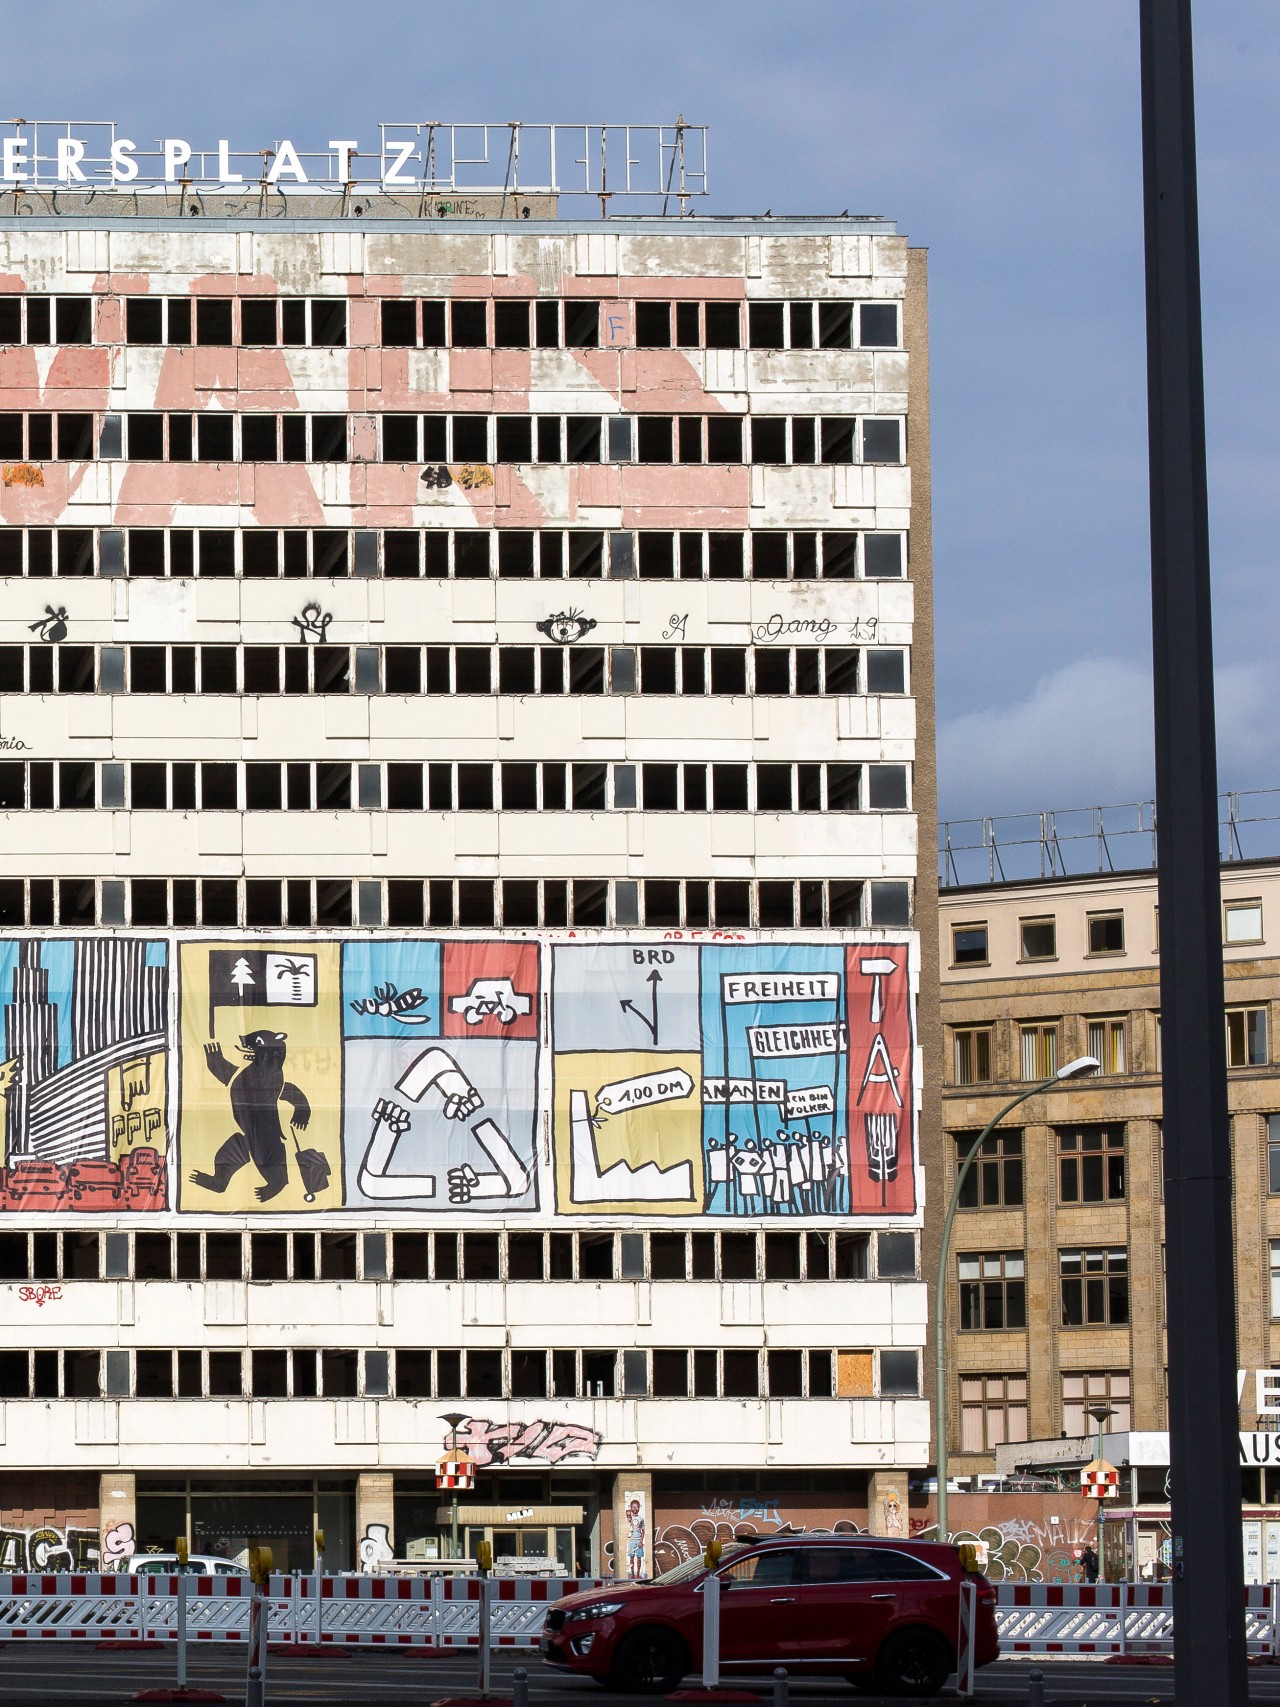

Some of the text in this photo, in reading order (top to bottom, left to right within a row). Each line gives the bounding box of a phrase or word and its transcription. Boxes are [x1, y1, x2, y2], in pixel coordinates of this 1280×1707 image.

[632, 949, 675, 965] BRD
[728, 979, 829, 998] FREIHEIT
[657, 1080, 685, 1095] DM
[809, 1092, 829, 1102] BIN
[505, 1507, 535, 1522] MLM
